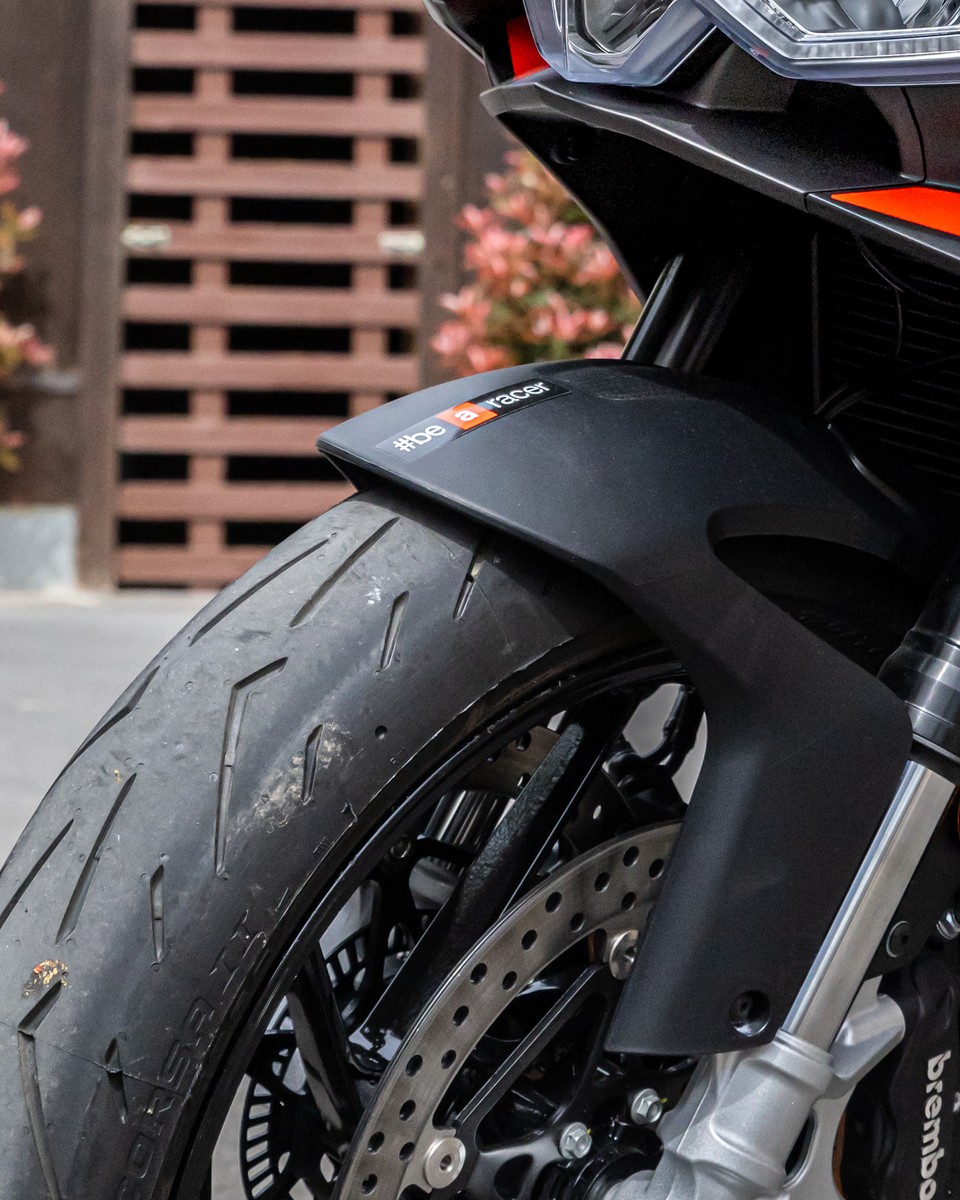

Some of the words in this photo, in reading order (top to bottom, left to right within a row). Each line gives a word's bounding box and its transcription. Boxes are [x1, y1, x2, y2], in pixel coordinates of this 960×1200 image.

[392, 424, 446, 453] #be
[454, 409, 479, 422] a
[485, 381, 550, 409] racer
[919, 1050, 951, 1200] brembo
